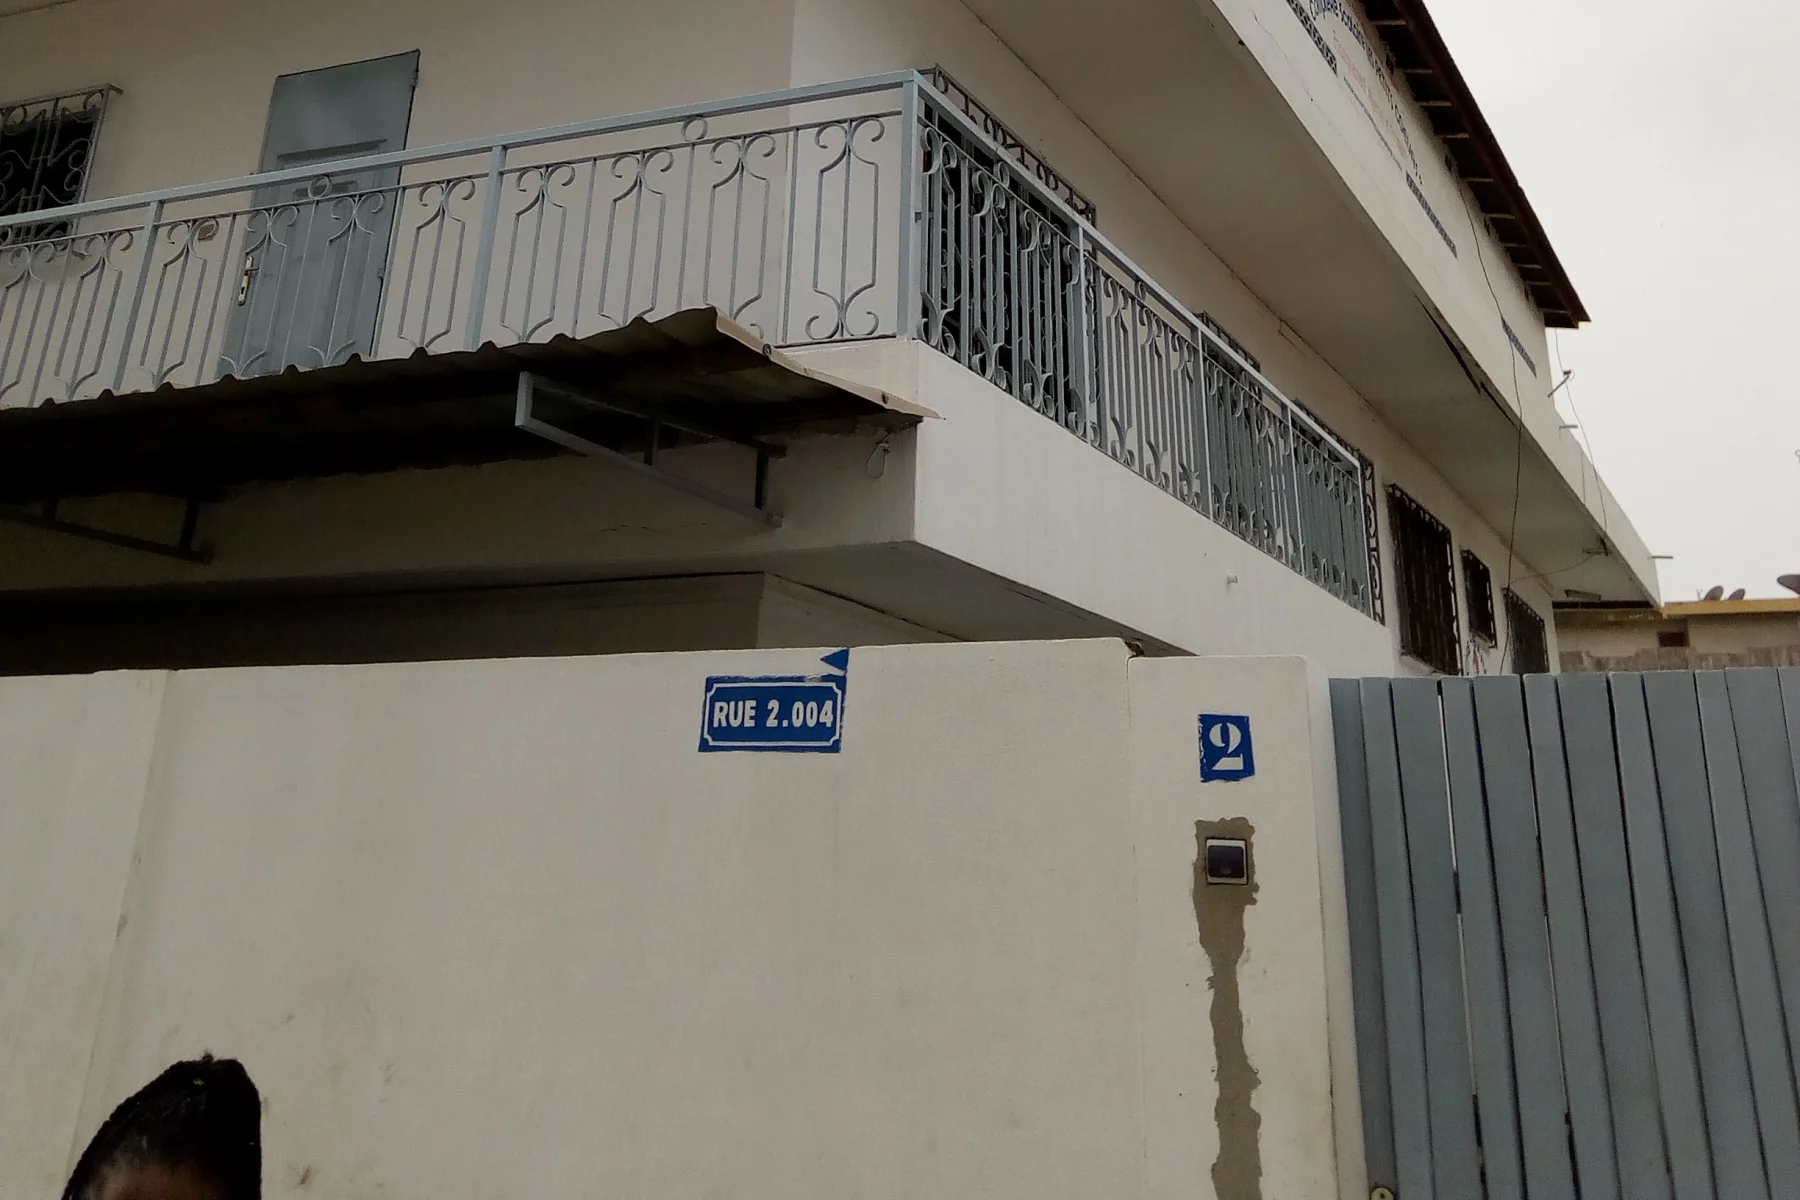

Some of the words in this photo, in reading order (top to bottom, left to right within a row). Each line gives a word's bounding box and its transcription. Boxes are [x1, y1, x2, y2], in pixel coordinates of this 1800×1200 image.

[712, 700, 757, 729] RUE
[765, 699, 834, 729] 2.004
[1208, 722, 1244, 771] 2
